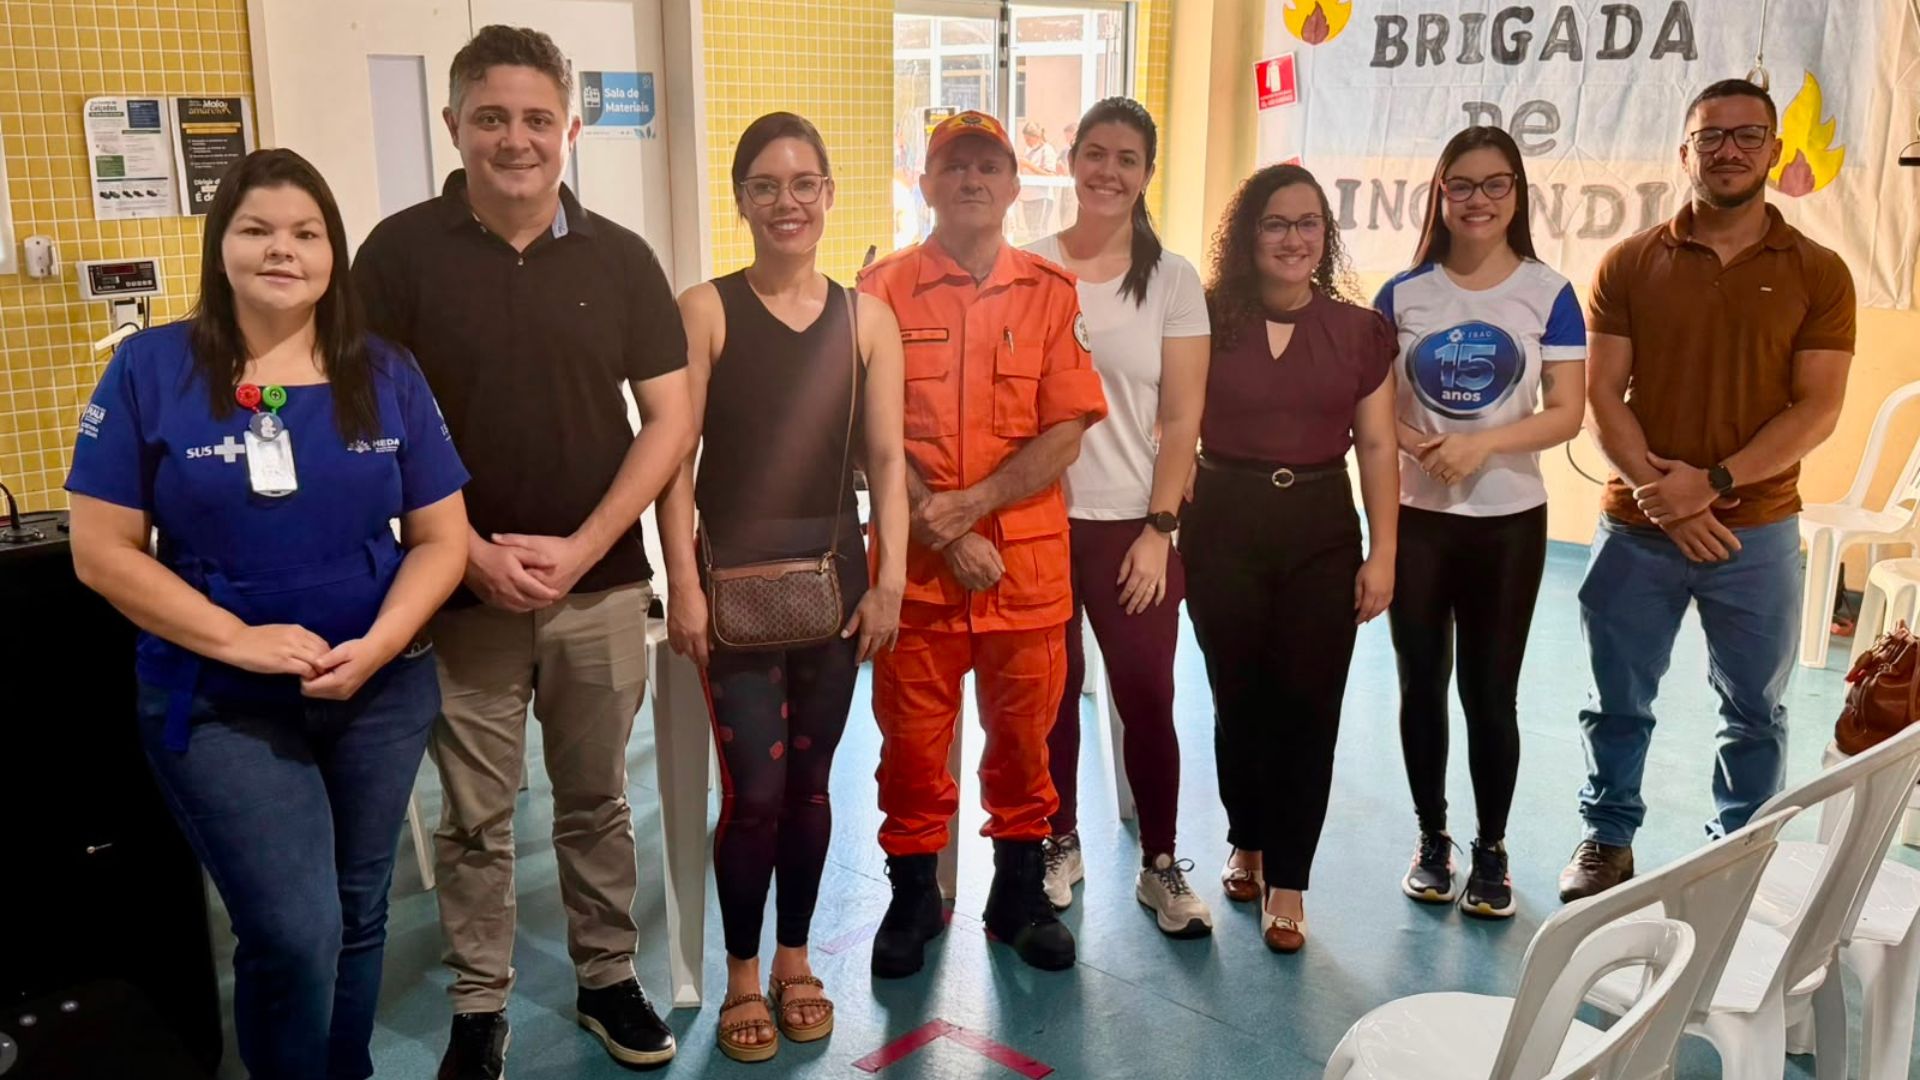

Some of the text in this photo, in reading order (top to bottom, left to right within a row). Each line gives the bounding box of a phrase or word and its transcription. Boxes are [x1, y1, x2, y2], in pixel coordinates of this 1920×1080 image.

[1370, 0, 1698, 68] BRIGADA
[604, 87, 639, 98] Sala de
[605, 102, 648, 112] Materiais
[1434, 343, 1496, 390] 15
[1441, 390, 1481, 402] anos
[186, 445, 213, 459] SUS
